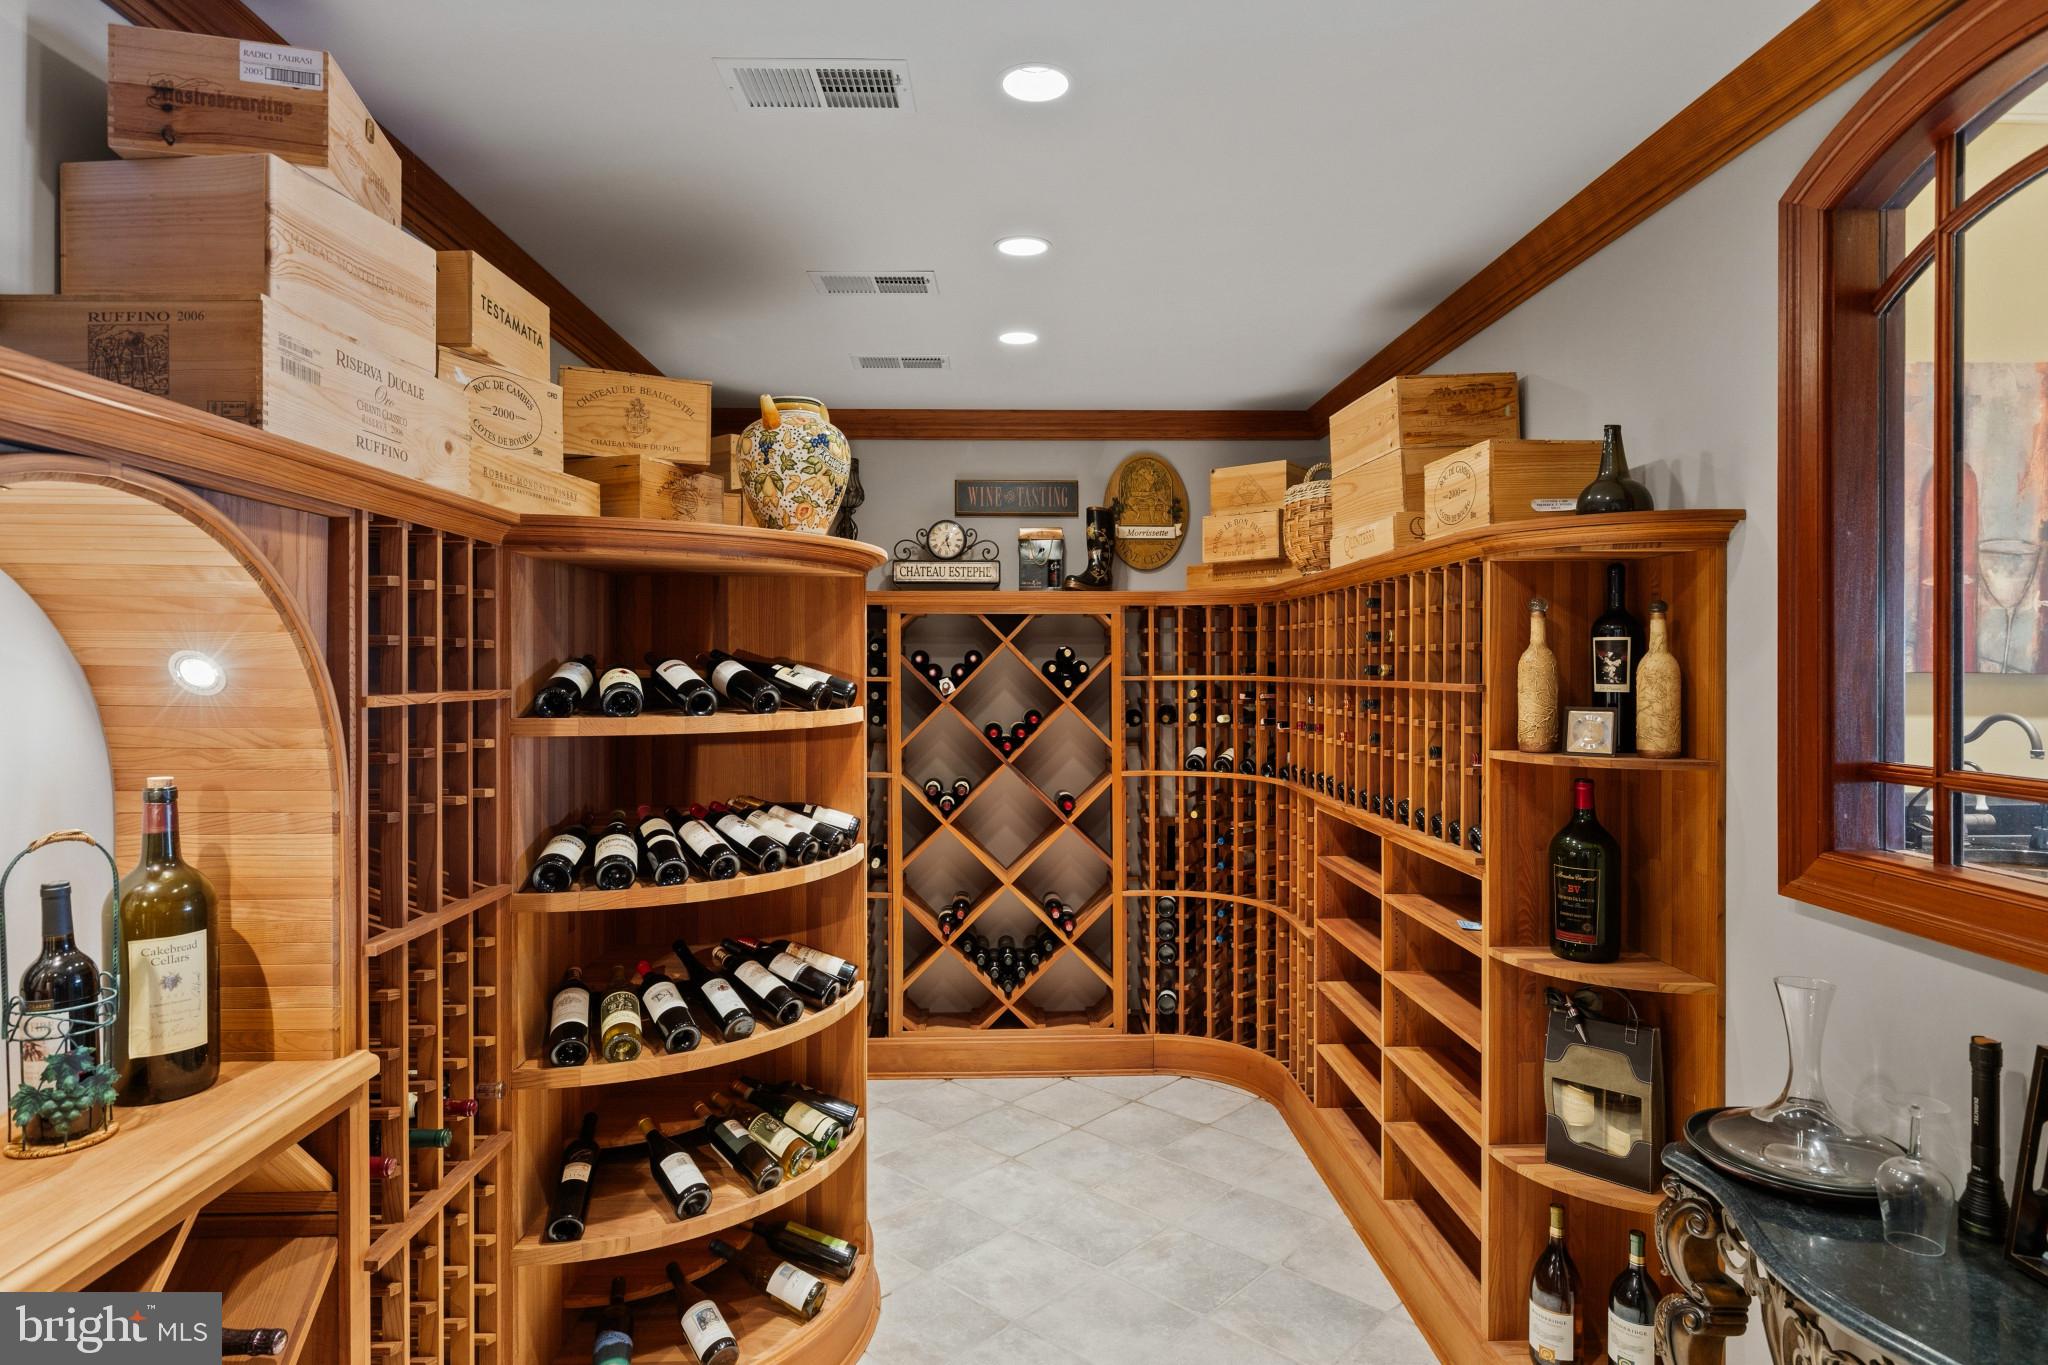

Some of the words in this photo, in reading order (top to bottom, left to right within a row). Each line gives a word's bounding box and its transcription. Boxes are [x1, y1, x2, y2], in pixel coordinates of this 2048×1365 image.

[243, 49, 273, 61] RADICI
[277, 52, 314, 66] TAURASI
[87, 310, 171, 323] RUFFINO
[176, 310, 206, 322] 2006
[480, 293, 544, 350] TESTAMATTA
[335, 348, 384, 384] RISERVA
[387, 370, 426, 401] DUCALE
[374, 384, 395, 407] Oro
[472, 379, 492, 395] ROC
[493, 380, 505, 391] DE
[506, 383, 534, 412] CAMBES
[576, 385, 619, 409] CHATEAU
[622, 385, 636, 394] DE
[640, 385, 696, 419] BEAUCASTEL
[356, 398, 382, 420] CHIANTI
[381, 408, 408, 428] CLASSICO
[491, 405, 515, 421] 2000
[472, 418, 497, 442] COTES
[497, 435, 509, 447] DE
[508, 430, 534, 447] BOURG
[355, 433, 409, 463] RUFFINO
[650, 443, 661, 451] DU
[663, 444, 681, 453] PAPE
[967, 485, 1002, 508] WINE
[1016, 485, 1069, 509] TASTING
[1126, 528, 1170, 537] Morrissette
[948, 566, 993, 579] ESTEPHE
[1567, 884, 1581, 894] BV
[140, 939, 198, 957] Cakebread
[150, 954, 190, 967] Cellars
